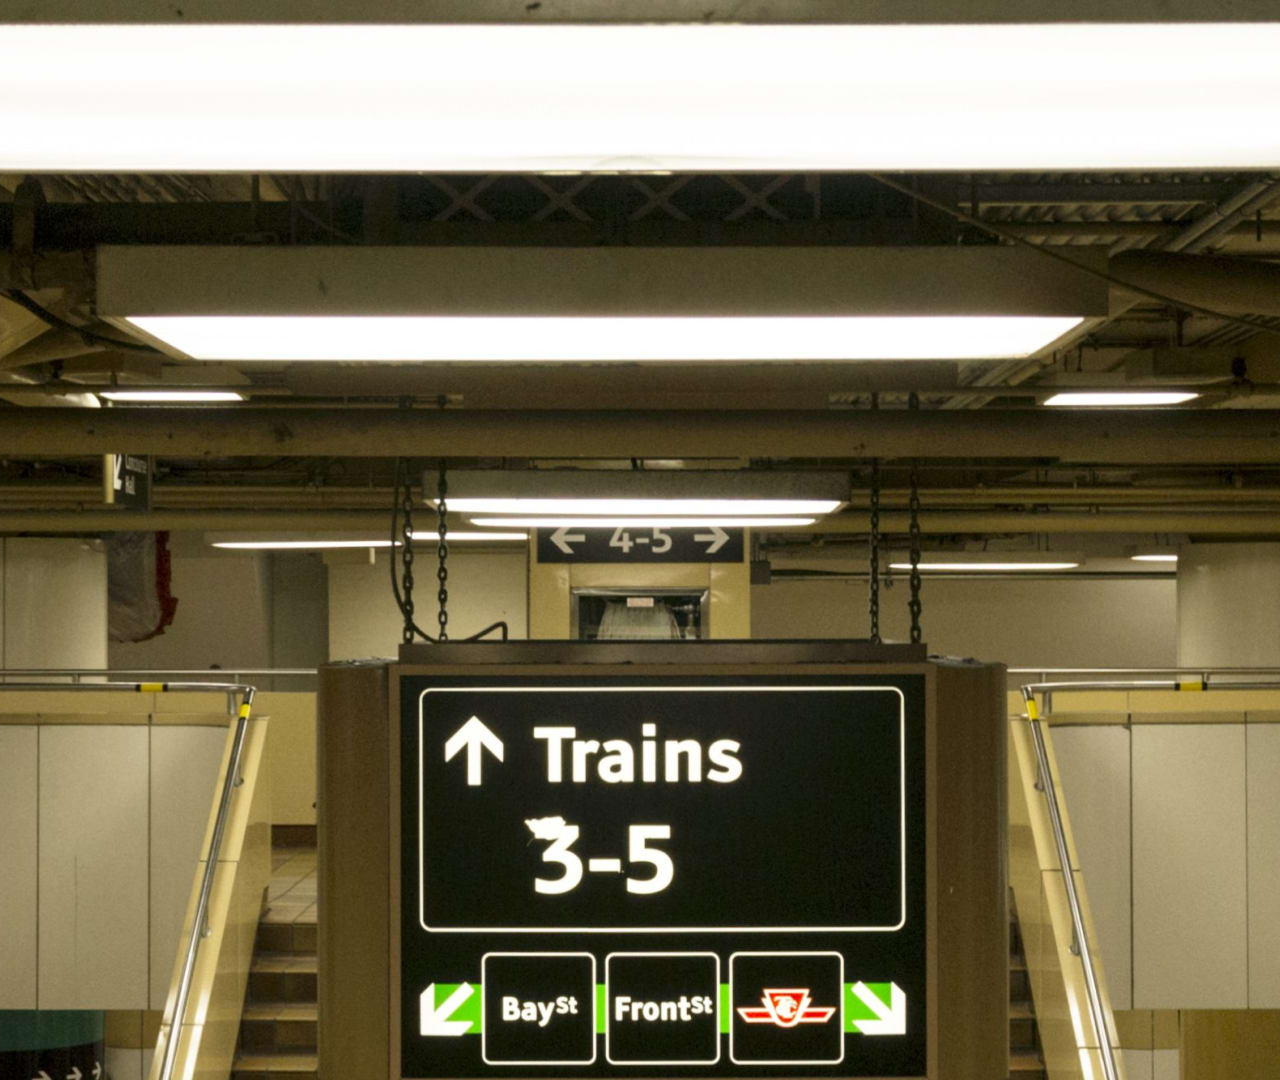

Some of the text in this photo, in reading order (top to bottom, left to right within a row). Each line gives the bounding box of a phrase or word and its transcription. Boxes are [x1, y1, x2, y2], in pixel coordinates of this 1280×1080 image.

[609, 526, 673, 554] 4-5
[532, 723, 744, 784] Trains
[502, 996, 555, 1027] Bay
[615, 996, 691, 1021] Front
